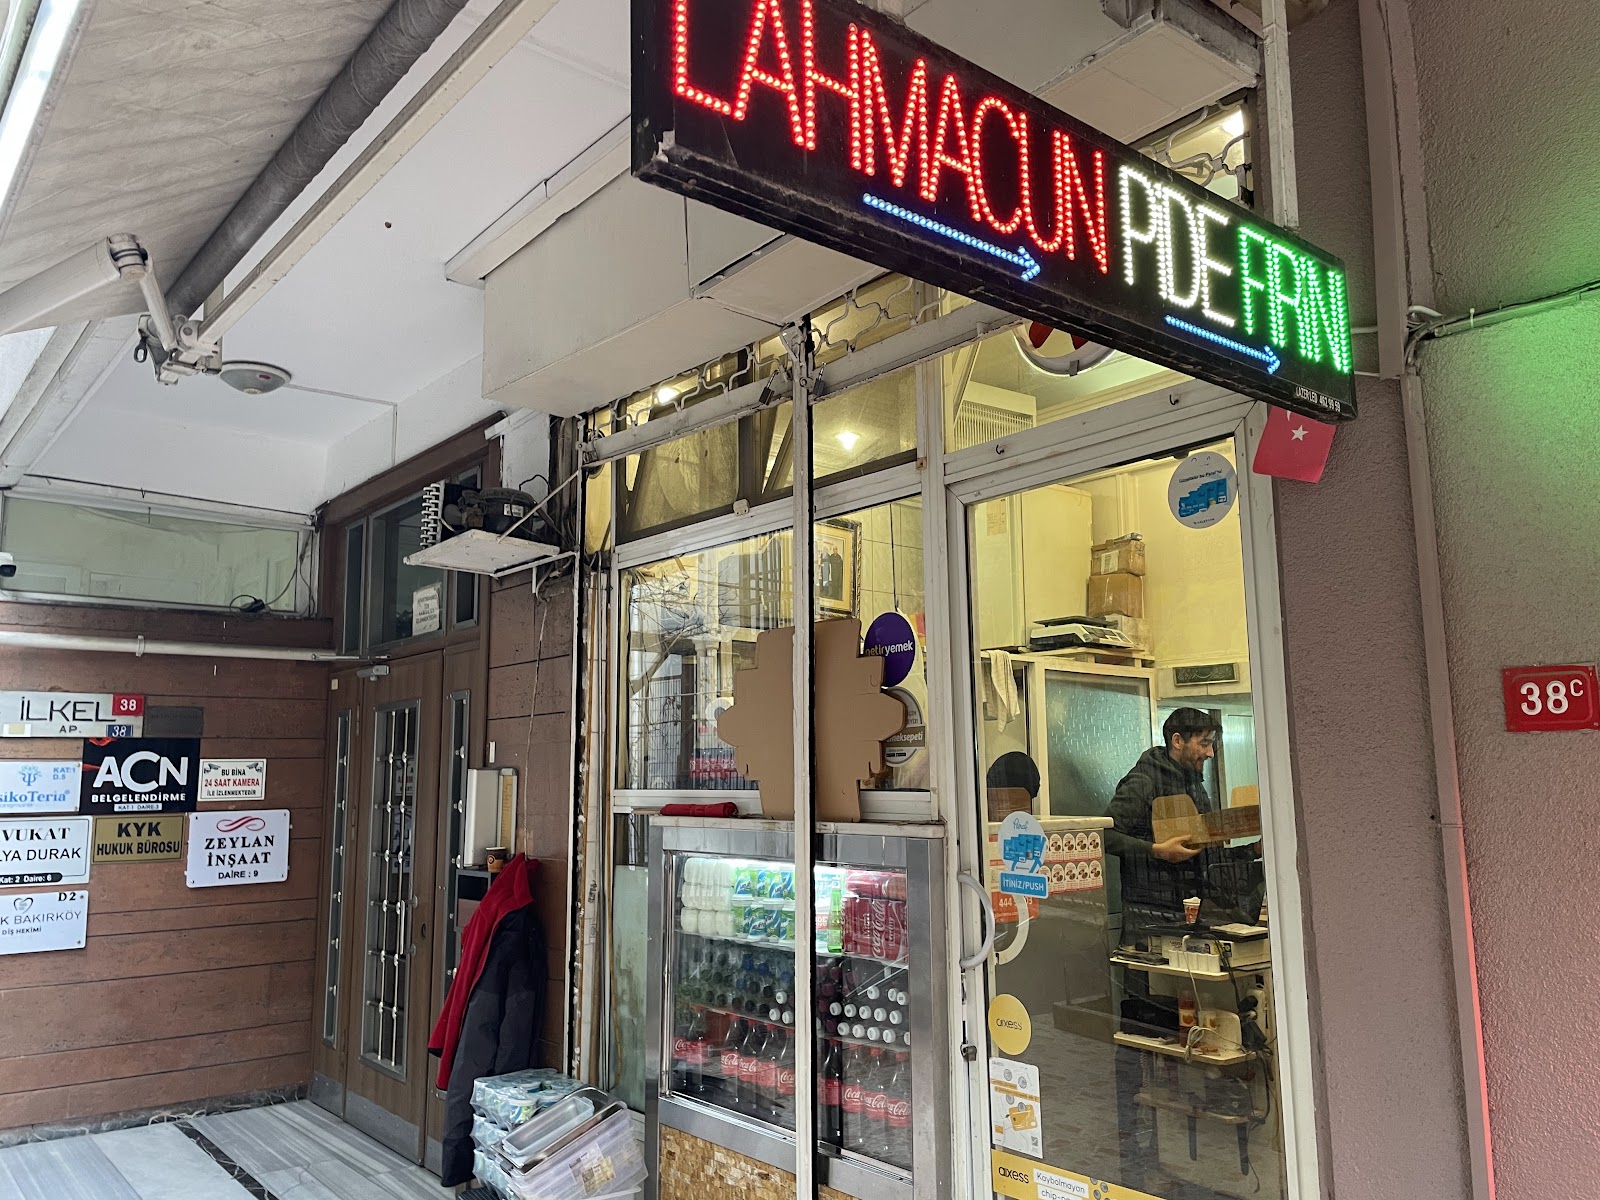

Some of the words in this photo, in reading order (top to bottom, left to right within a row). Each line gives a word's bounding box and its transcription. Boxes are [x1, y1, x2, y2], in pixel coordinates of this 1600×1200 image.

[672, 0, 1109, 274] LAHMACUN
[20, 696, 116, 722] İLKEL
[120, 698, 137, 711] 38
[111, 725, 127, 737] 38
[92, 750, 189, 793] ACN
[231, 767, 246, 776] BİNA
[204, 779, 213, 787] 24
[214, 779, 231, 787] SAAT
[232, 778, 260, 787] KAMERA
[91, 792, 186, 803] BELGELENDİRME
[207, 789, 216, 797] İLE
[216, 789, 257, 797] İZLENMEKTEDİR
[117, 822, 161, 838] KYK
[96, 842, 133, 855] HUKUK
[137, 840, 180, 854] BÜROSU
[204, 835, 275, 850] ZEYLAN
[27, 848, 81, 861] DURAK
[207, 852, 271, 868] İNŞAAT
[46, 874, 52, 882] 6
[218, 870, 246, 880] DAİRE
[14, 910, 81, 925] BAKIRKÖY
[1, 928, 14, 936] DİŞ
[16, 926, 42, 934] HEKİMİ
[996, 1018, 1023, 1031] axess
[998, 1166, 1030, 1184] axess
[1036, 1172, 1085, 1194] Kaybolmayan
